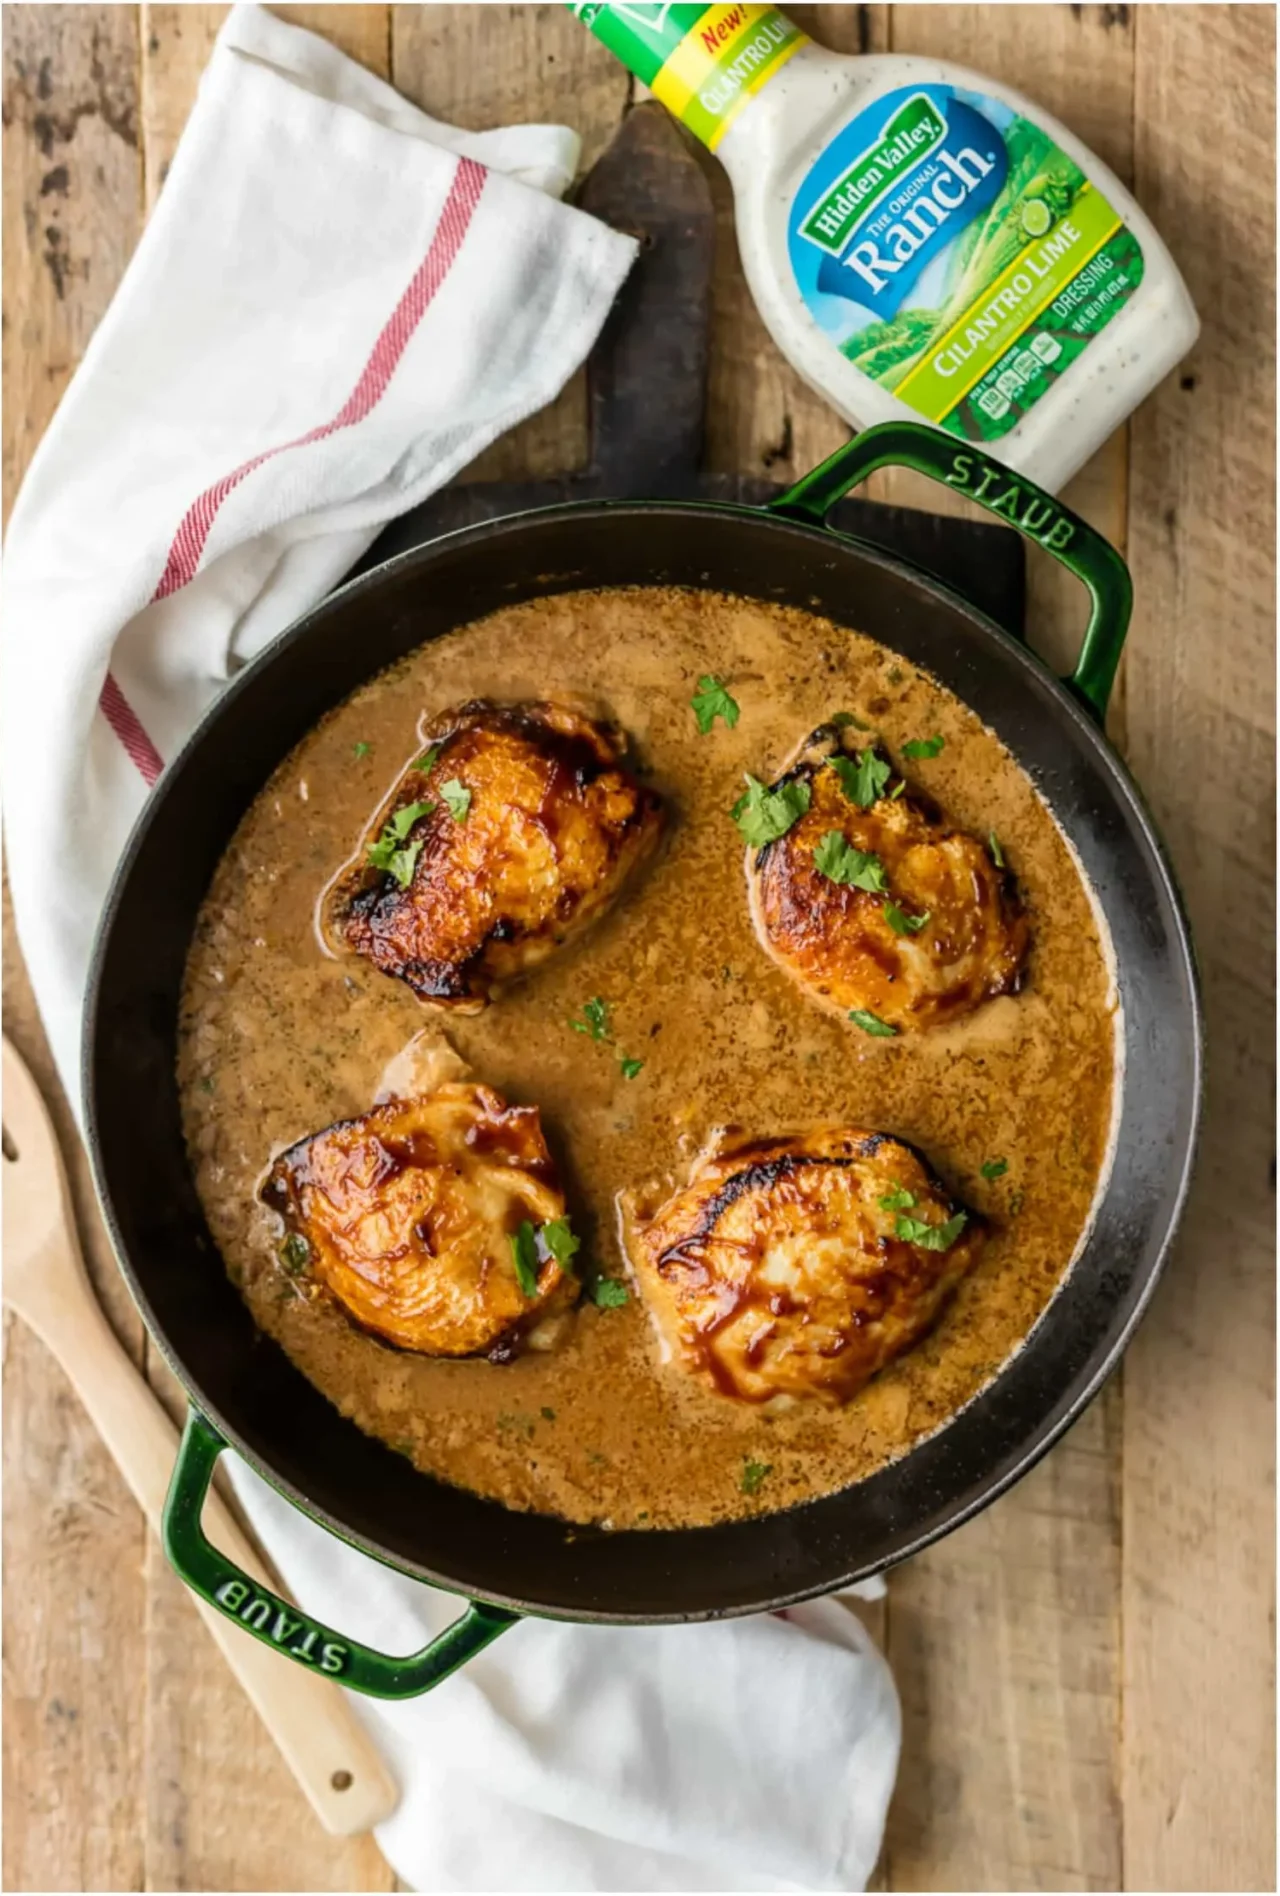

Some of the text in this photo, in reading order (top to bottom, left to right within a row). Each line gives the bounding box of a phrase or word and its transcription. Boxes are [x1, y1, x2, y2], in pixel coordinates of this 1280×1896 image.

[699, 4, 748, 54] New!
[699, 36, 774, 115] CILANTRO
[814, 168, 880, 239] Hidden
[842, 149, 995, 295] Ranch
[866, 163, 940, 238] THE ORIGINAL
[932, 272, 1033, 378] CILANTRO
[1035, 220, 1082, 279] LIME
[1051, 252, 1114, 319] DRESSING
[945, 454, 1075, 548] STAUB
[215, 1581, 347, 1673] STAUB
